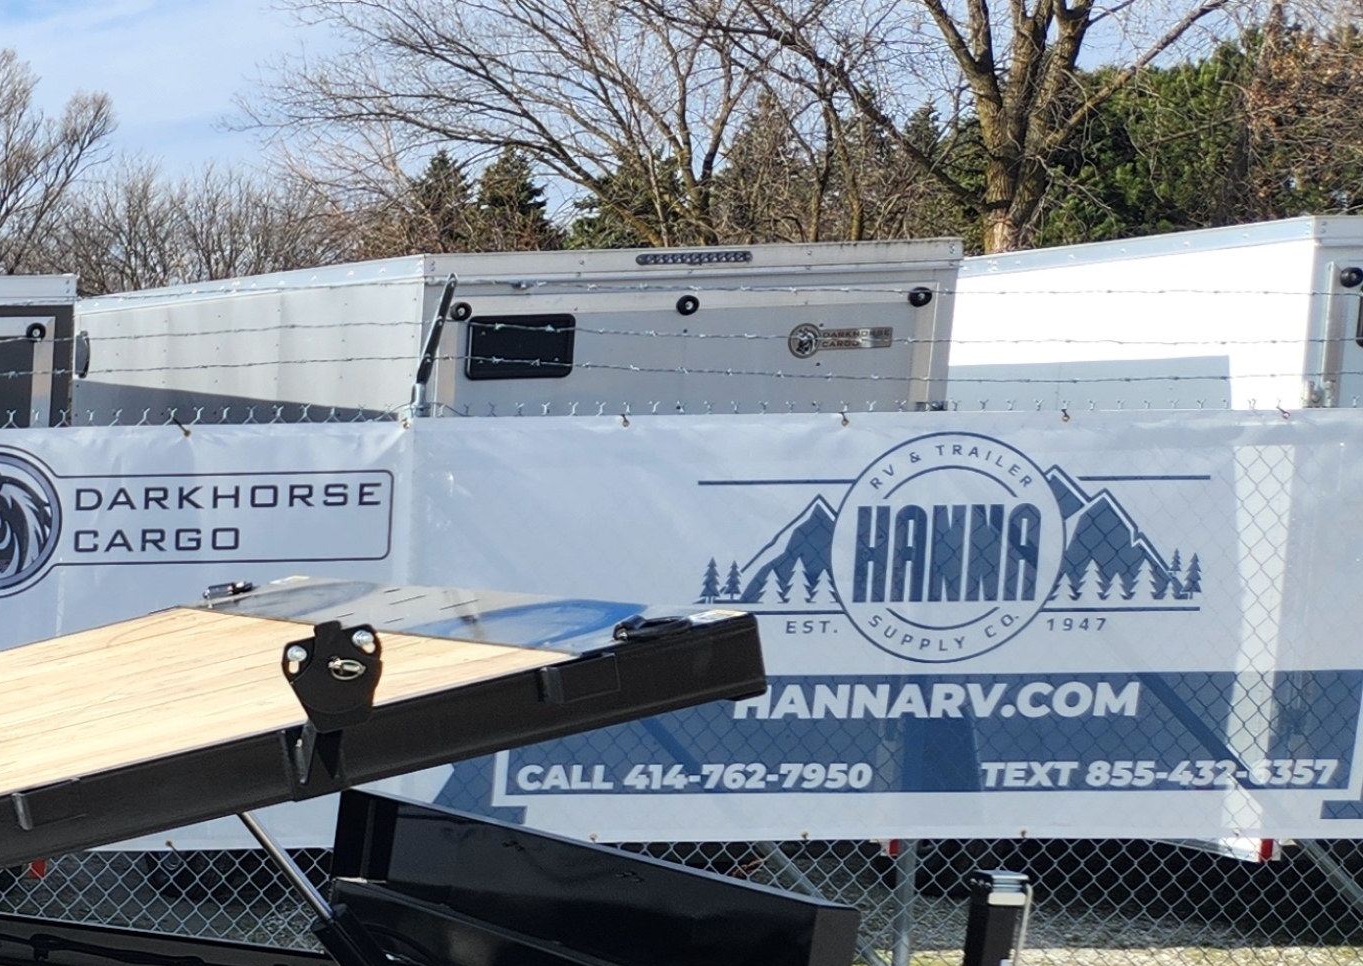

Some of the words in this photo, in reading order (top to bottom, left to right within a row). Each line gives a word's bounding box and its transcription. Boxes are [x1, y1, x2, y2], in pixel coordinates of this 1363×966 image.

[868, 464, 895, 490] RV
[935, 443, 1034, 488] TRAILER
[74, 482, 382, 512] DARKHORSE
[73, 527, 241, 552] CARGO
[851, 502, 1043, 604] HANNA
[785, 620, 838, 634] EST.
[869, 613, 966, 651] SUPPLY
[1046, 617, 1107, 632] 1947
[732, 681, 1140, 720] HANNARV.COM
[515, 763, 614, 791] CALL
[623, 761, 874, 791] 414-762-7950
[980, 760, 1079, 788] TEXT
[1085, 758, 1339, 787] 855-432-6357
